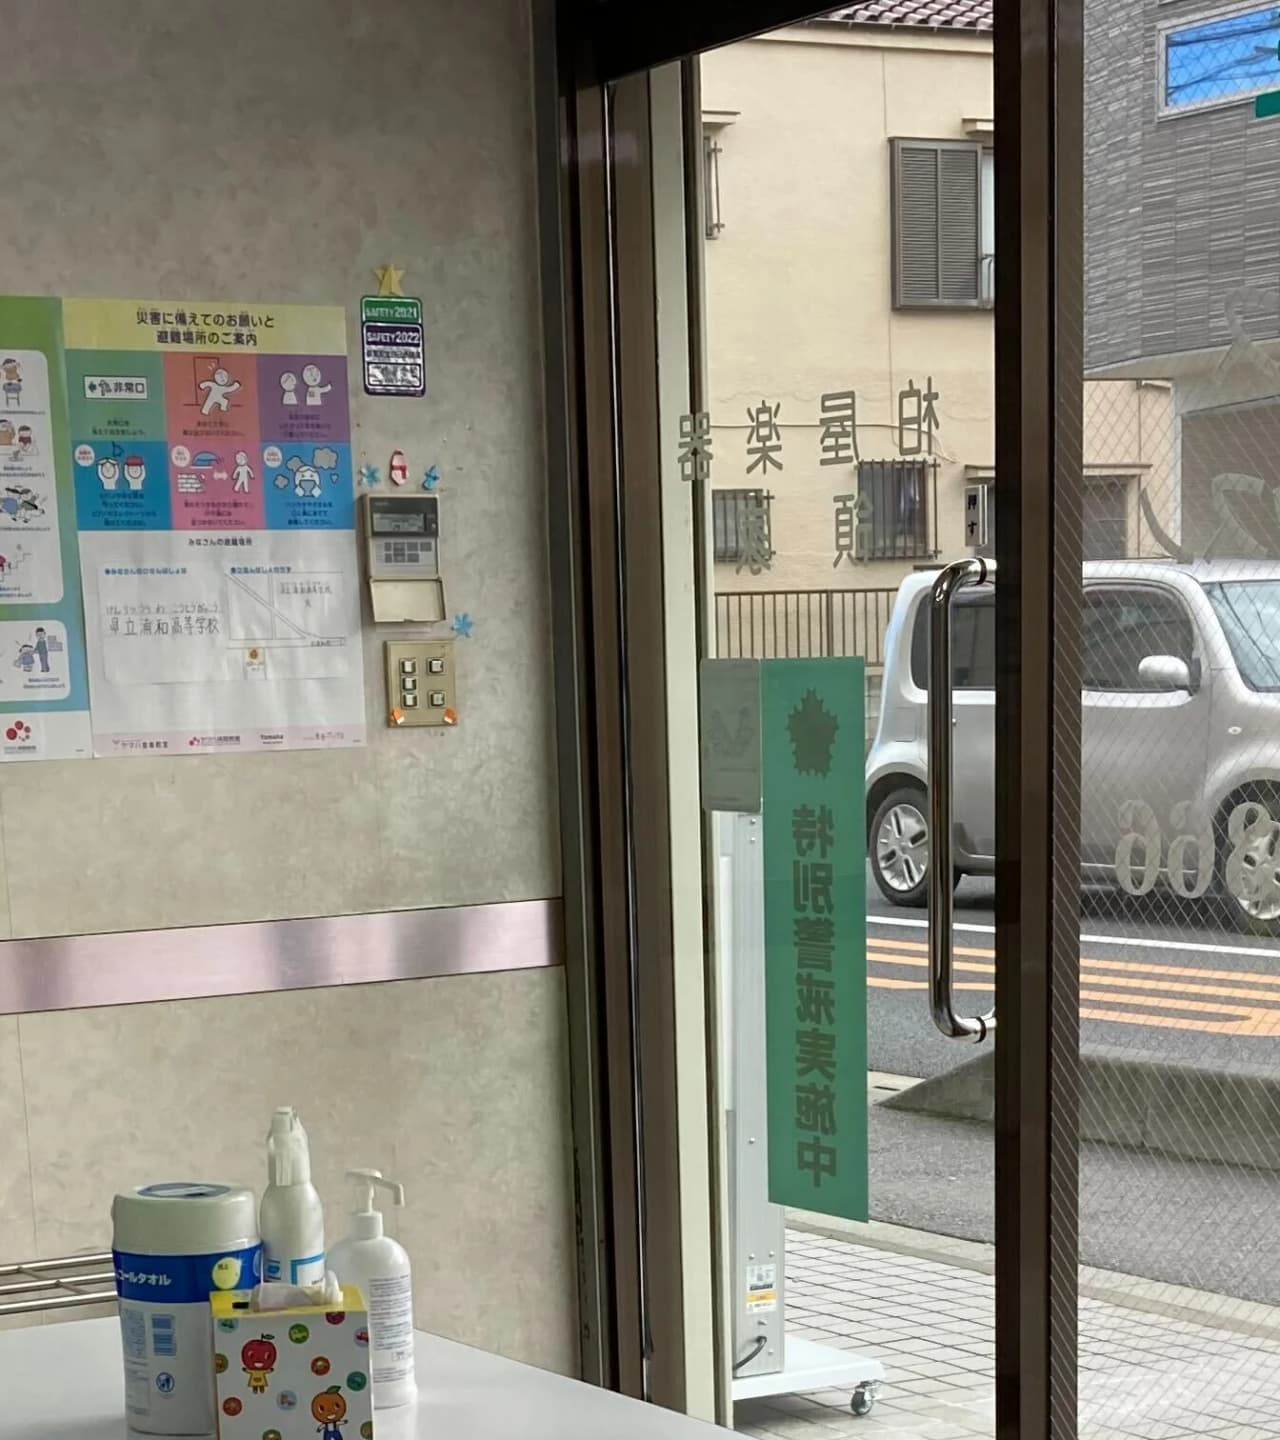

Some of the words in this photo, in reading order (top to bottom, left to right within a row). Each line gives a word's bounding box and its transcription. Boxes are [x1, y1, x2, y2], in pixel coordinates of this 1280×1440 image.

[137, 311, 274, 328] 災害に備えてのお願いと
[157, 330, 257, 346] 避難場所のご案内
[114, 382, 144, 393] 非常口
